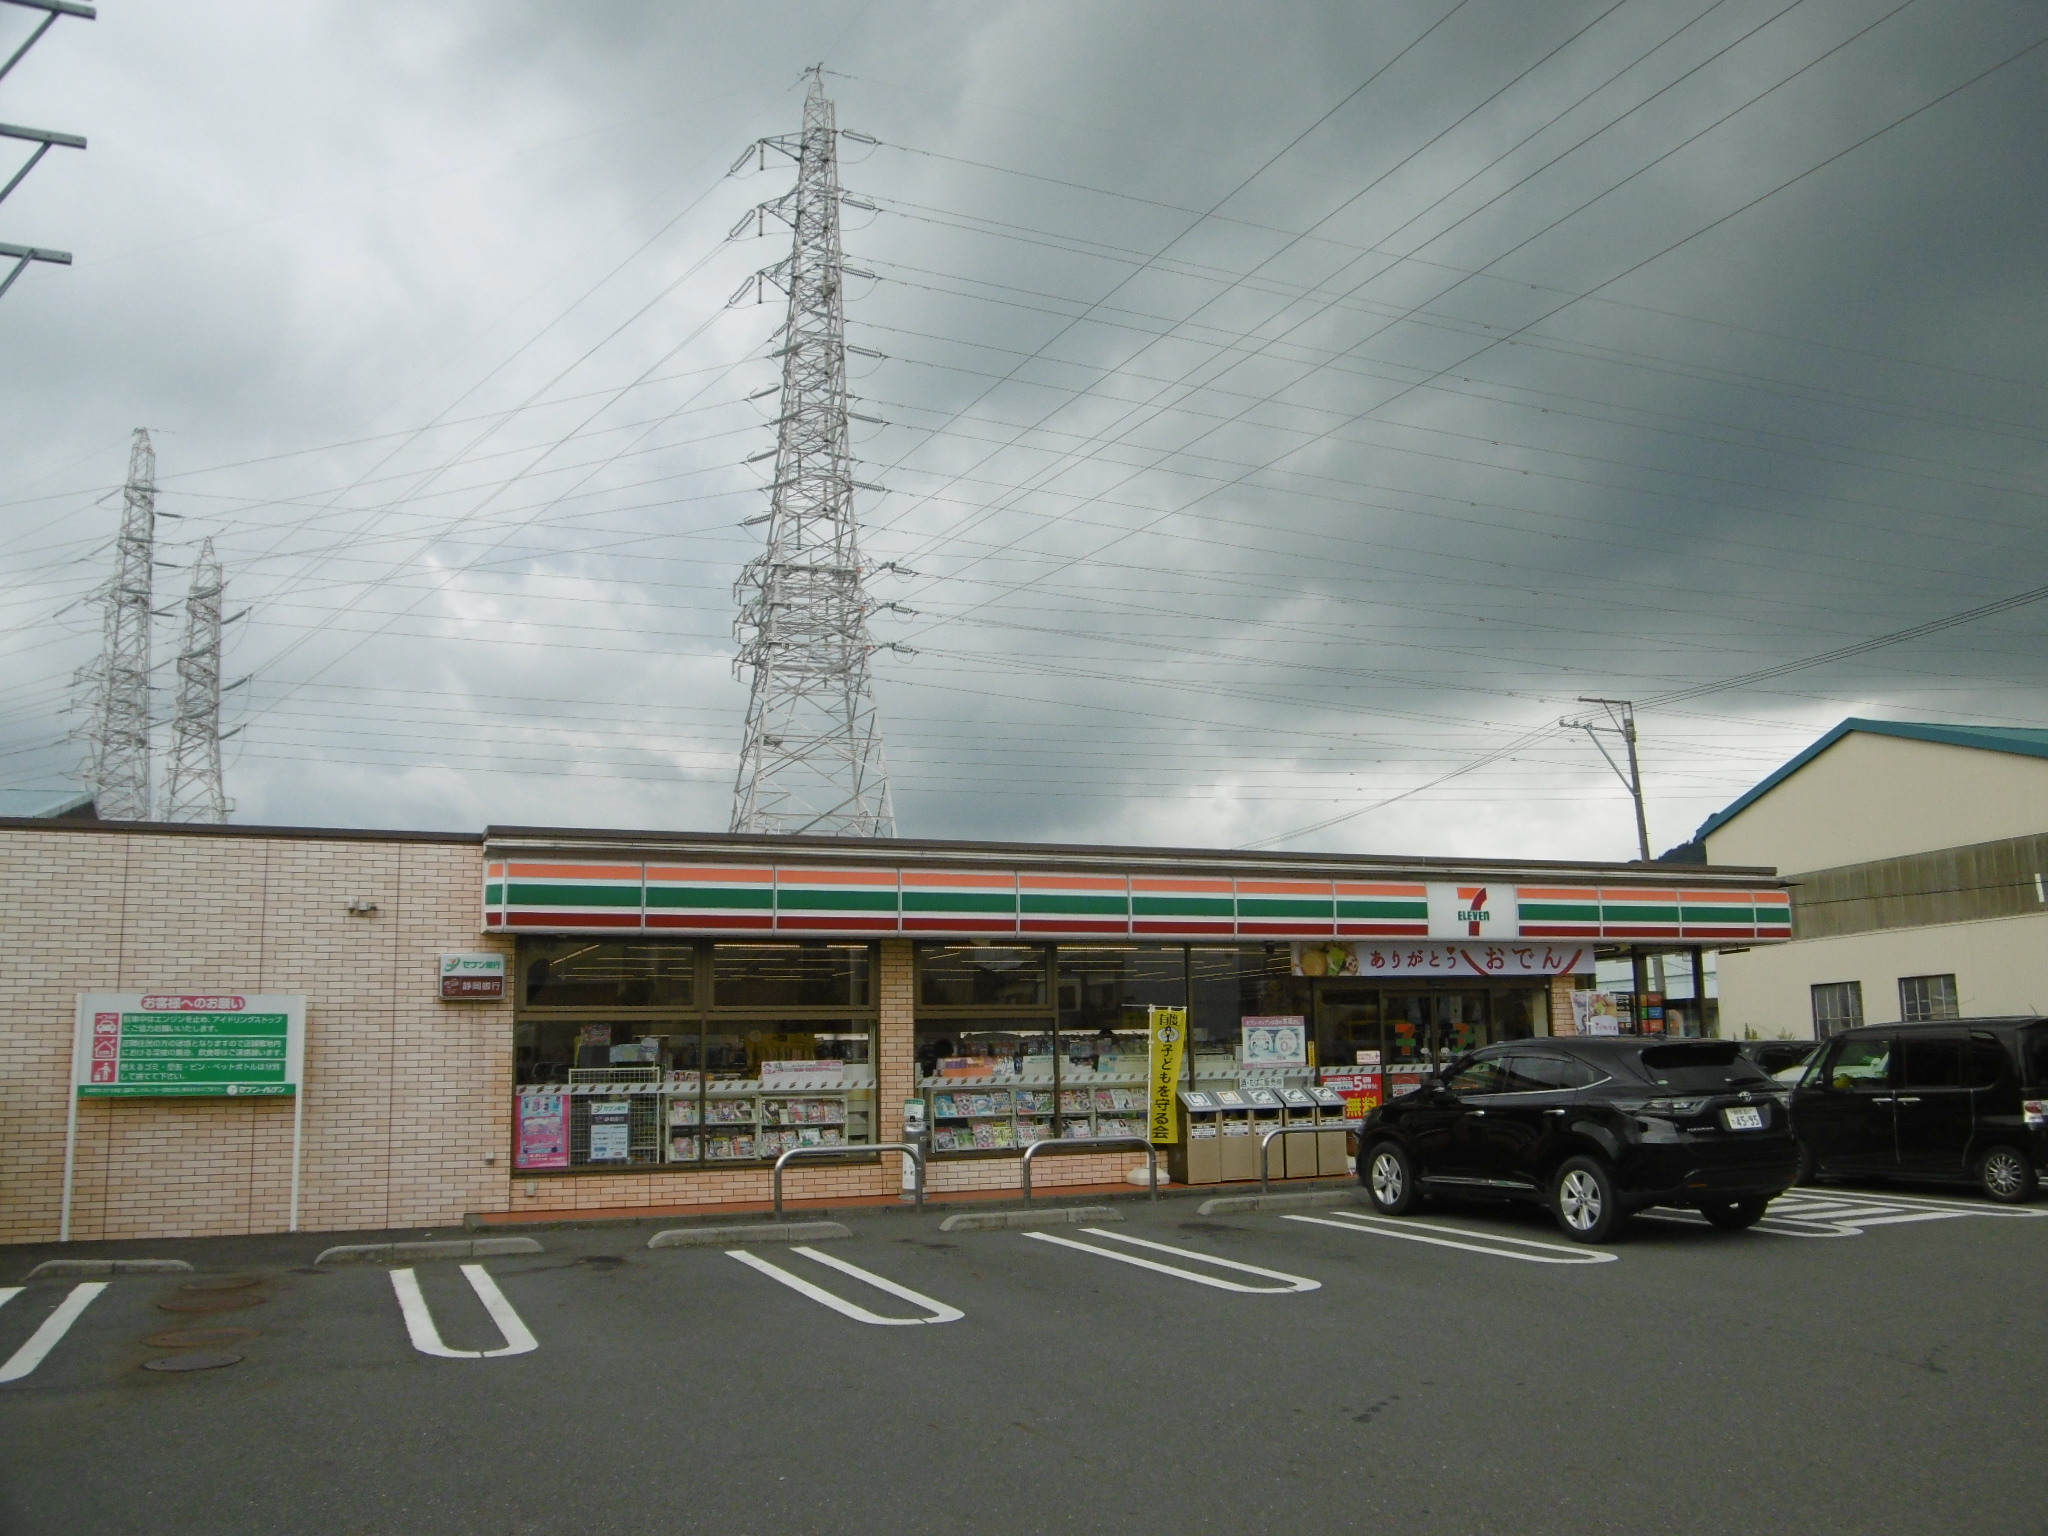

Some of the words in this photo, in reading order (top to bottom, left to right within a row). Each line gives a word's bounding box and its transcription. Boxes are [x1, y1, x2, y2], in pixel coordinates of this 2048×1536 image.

[1457, 887, 1488, 937] 7
[1457, 910, 1490, 921] ELEVEN
[462, 961, 501, 969] セブン銀行
[1370, 947, 1457, 969] ありがとう
[1485, 947, 1562, 970] おでん
[462, 981, 501, 991] 静岡銀行
[142, 997, 244, 1010] お客様へのお願い
[1152, 1044, 1174, 1140] 子どもを守る会
